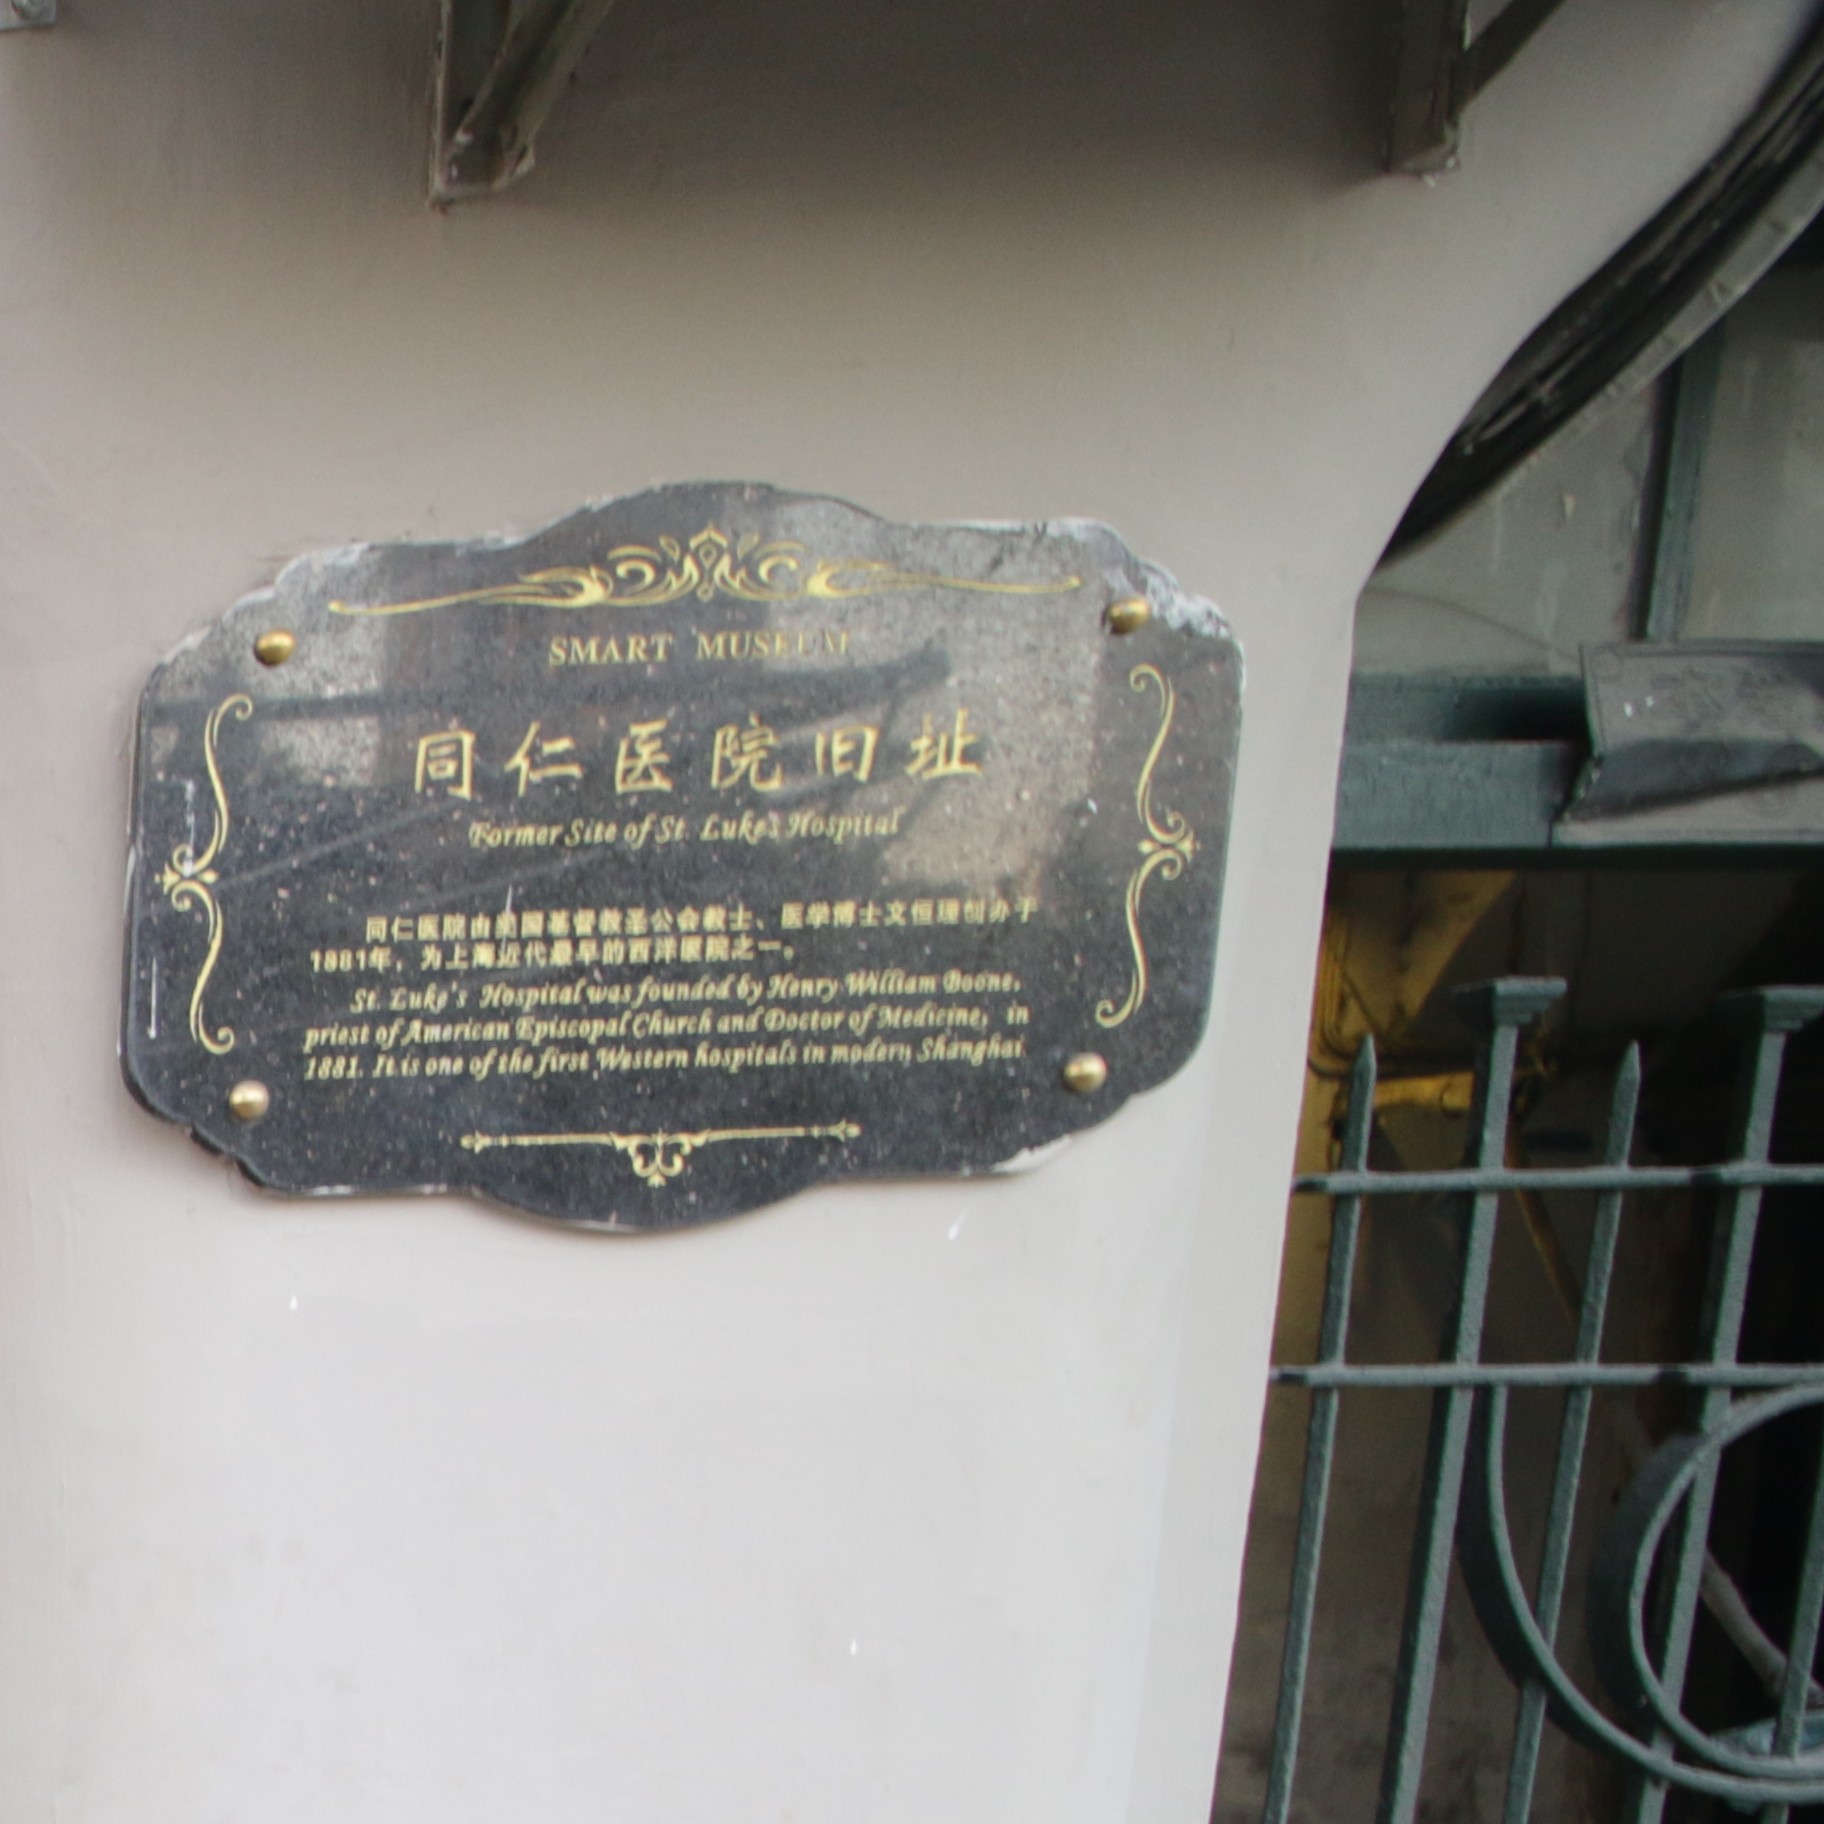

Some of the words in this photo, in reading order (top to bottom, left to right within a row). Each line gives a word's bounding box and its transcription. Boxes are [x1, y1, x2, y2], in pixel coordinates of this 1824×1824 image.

[549, 632, 673, 666] SMART
[696, 627, 851, 661] MUSEUM
[414, 707, 983, 800] 同仁医院旧址
[468, 820, 563, 848] Former
[564, 817, 617, 846] Site
[622, 812, 656, 848] of
[784, 805, 903, 844] Hospital
[388, 981, 469, 1014] Luke's
[478, 977, 588, 1013] Hospital
[586, 982, 633, 1004] was
[630, 972, 736, 1010] founded
[736, 972, 764, 1007] by
[766, 972, 839, 1004] Henry
[845, 967, 938, 996] William
[303, 1021, 371, 1054] priest
[374, 1017, 405, 1051] of
[401, 1017, 511, 1046] American
[516, 1009, 632, 1047] Episcopal
[632, 1006, 714, 1039] Church
[716, 1004, 765, 1034] and
[764, 1006, 845, 1033] Doctor
[848, 1002, 879, 1037] of
[1007, 998, 1032, 1026] in
[373, 1053, 396, 1079] It
[401, 1051, 421, 1077] is
[425, 1056, 464, 1076] one
[469, 1046, 498, 1082] of
[498, 1047, 534, 1075] the
[532, 1044, 591, 1080] first
[596, 1045, 689, 1072] Western
[694, 1038, 798, 1074] hospitals
[802, 1039, 825, 1065] in
[830, 1034, 912, 1066] modern
